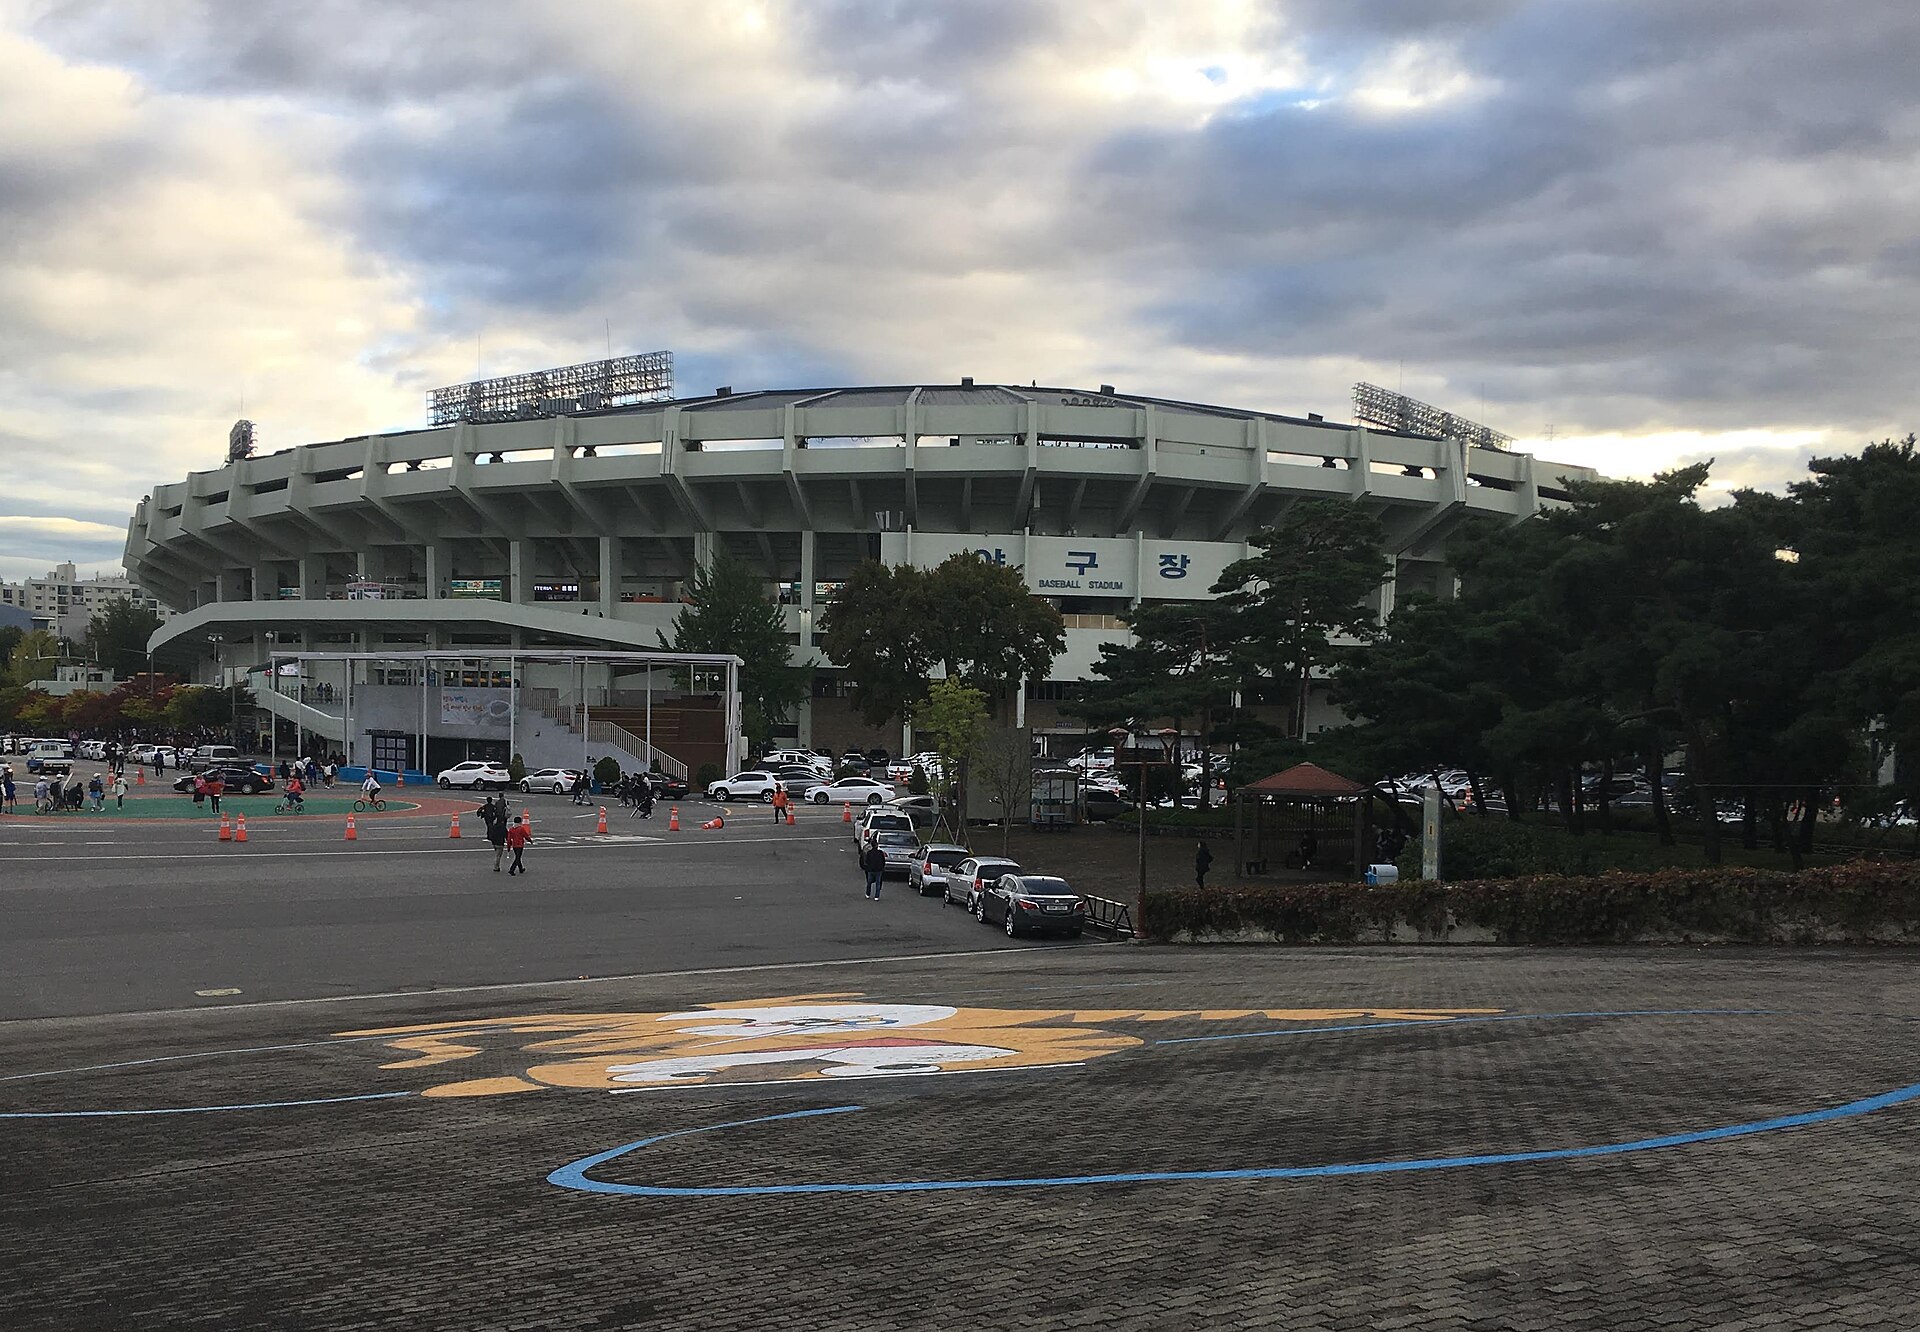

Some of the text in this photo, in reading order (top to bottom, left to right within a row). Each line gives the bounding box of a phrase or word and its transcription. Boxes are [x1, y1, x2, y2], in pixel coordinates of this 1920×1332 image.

[1065, 551, 1099, 576] 구
[1158, 554, 1191, 579] 장
[1039, 579, 1123, 590] BASEBALL STADIUM
